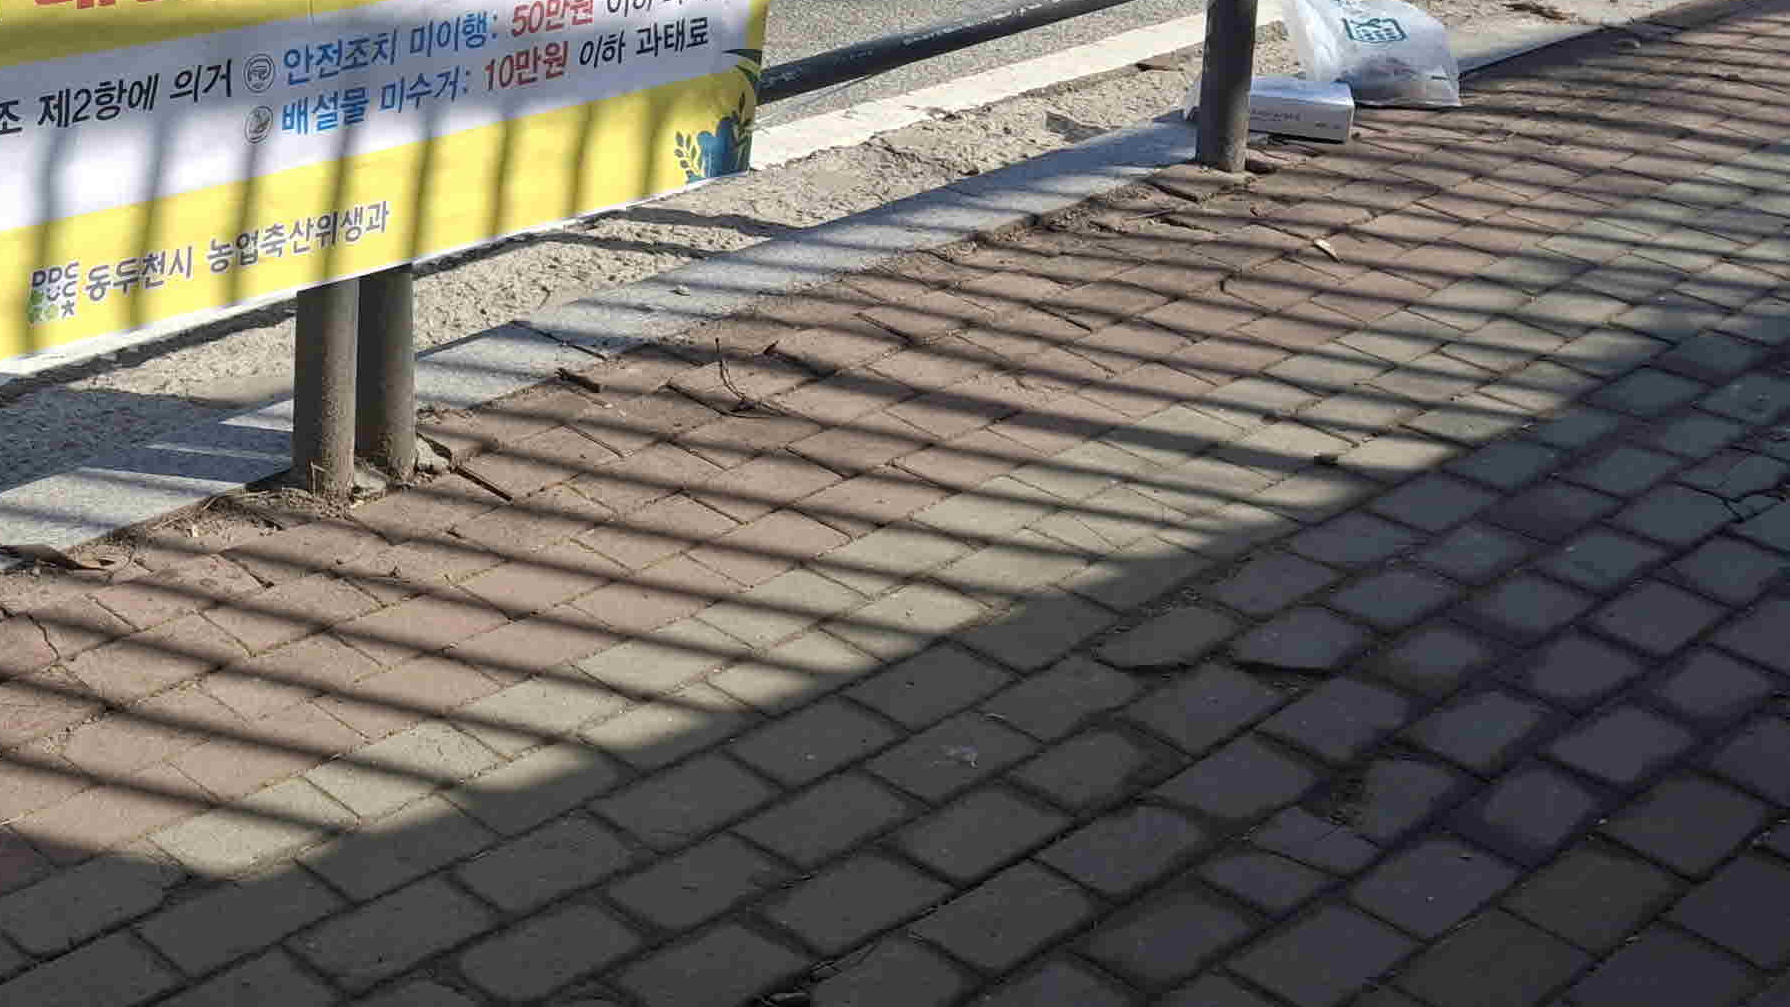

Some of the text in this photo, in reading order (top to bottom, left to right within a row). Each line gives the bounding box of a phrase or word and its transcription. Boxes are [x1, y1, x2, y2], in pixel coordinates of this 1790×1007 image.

[280, 15, 710, 136] 배설물 미수거: 10만원 이하 과태료
[282, 28, 399, 86] 안전조치
[410, 10, 499, 58] 미이행:
[37, 72, 160, 130] 제2항에
[168, 58, 234, 103] 의거
[84, 200, 391, 303] 동두천시 농업축산위생과
